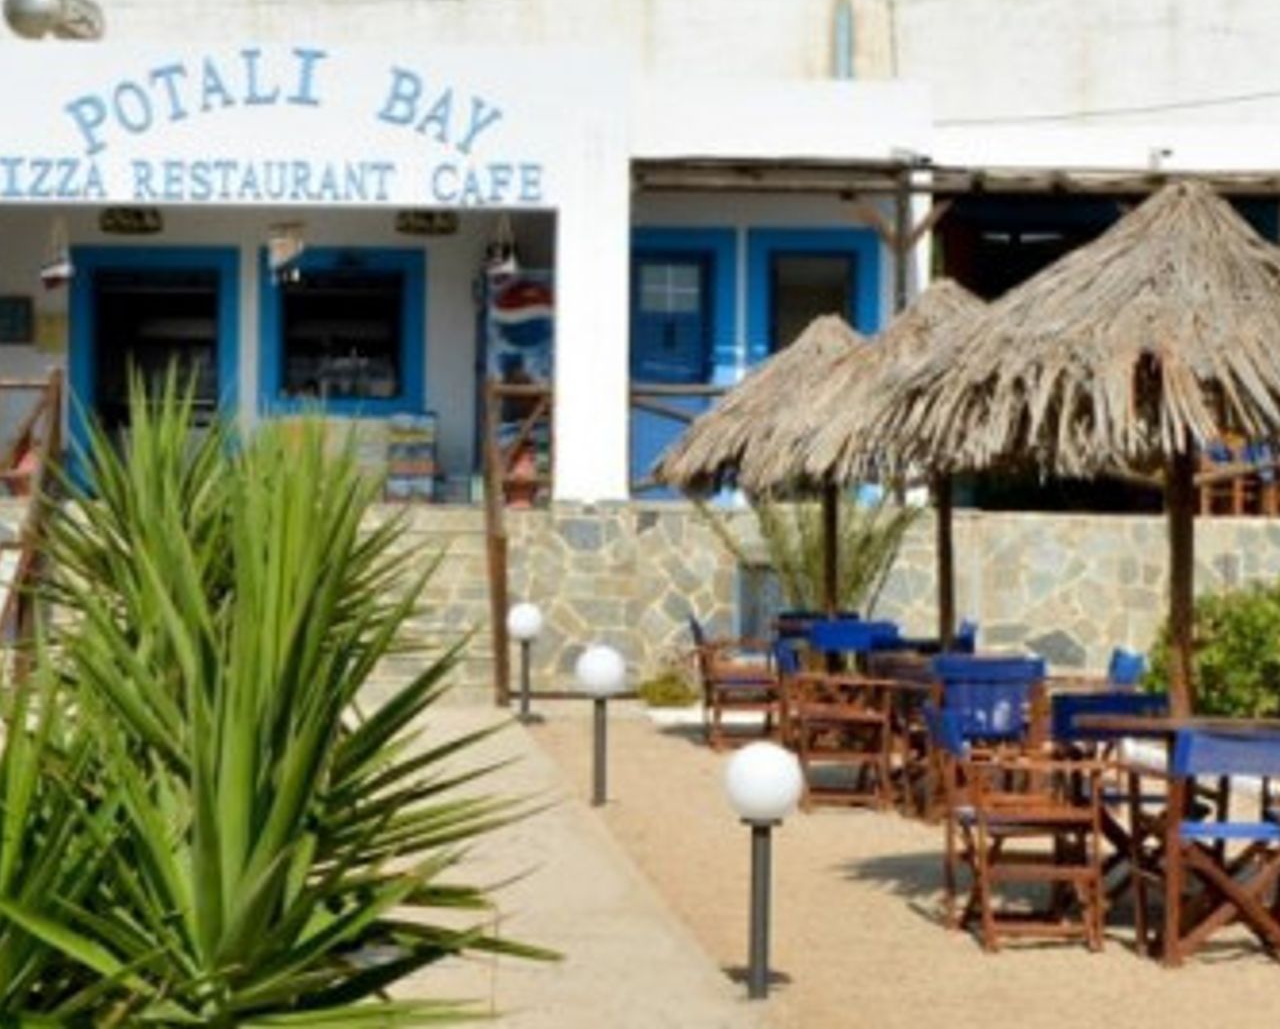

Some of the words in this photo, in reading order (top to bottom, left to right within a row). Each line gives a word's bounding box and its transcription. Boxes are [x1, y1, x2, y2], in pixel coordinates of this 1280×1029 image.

[65, 48, 327, 155] POTALI
[377, 67, 503, 154] BAY
[131, 159, 394, 201] RESTAURANT
[431, 162, 543, 203] CAFE
